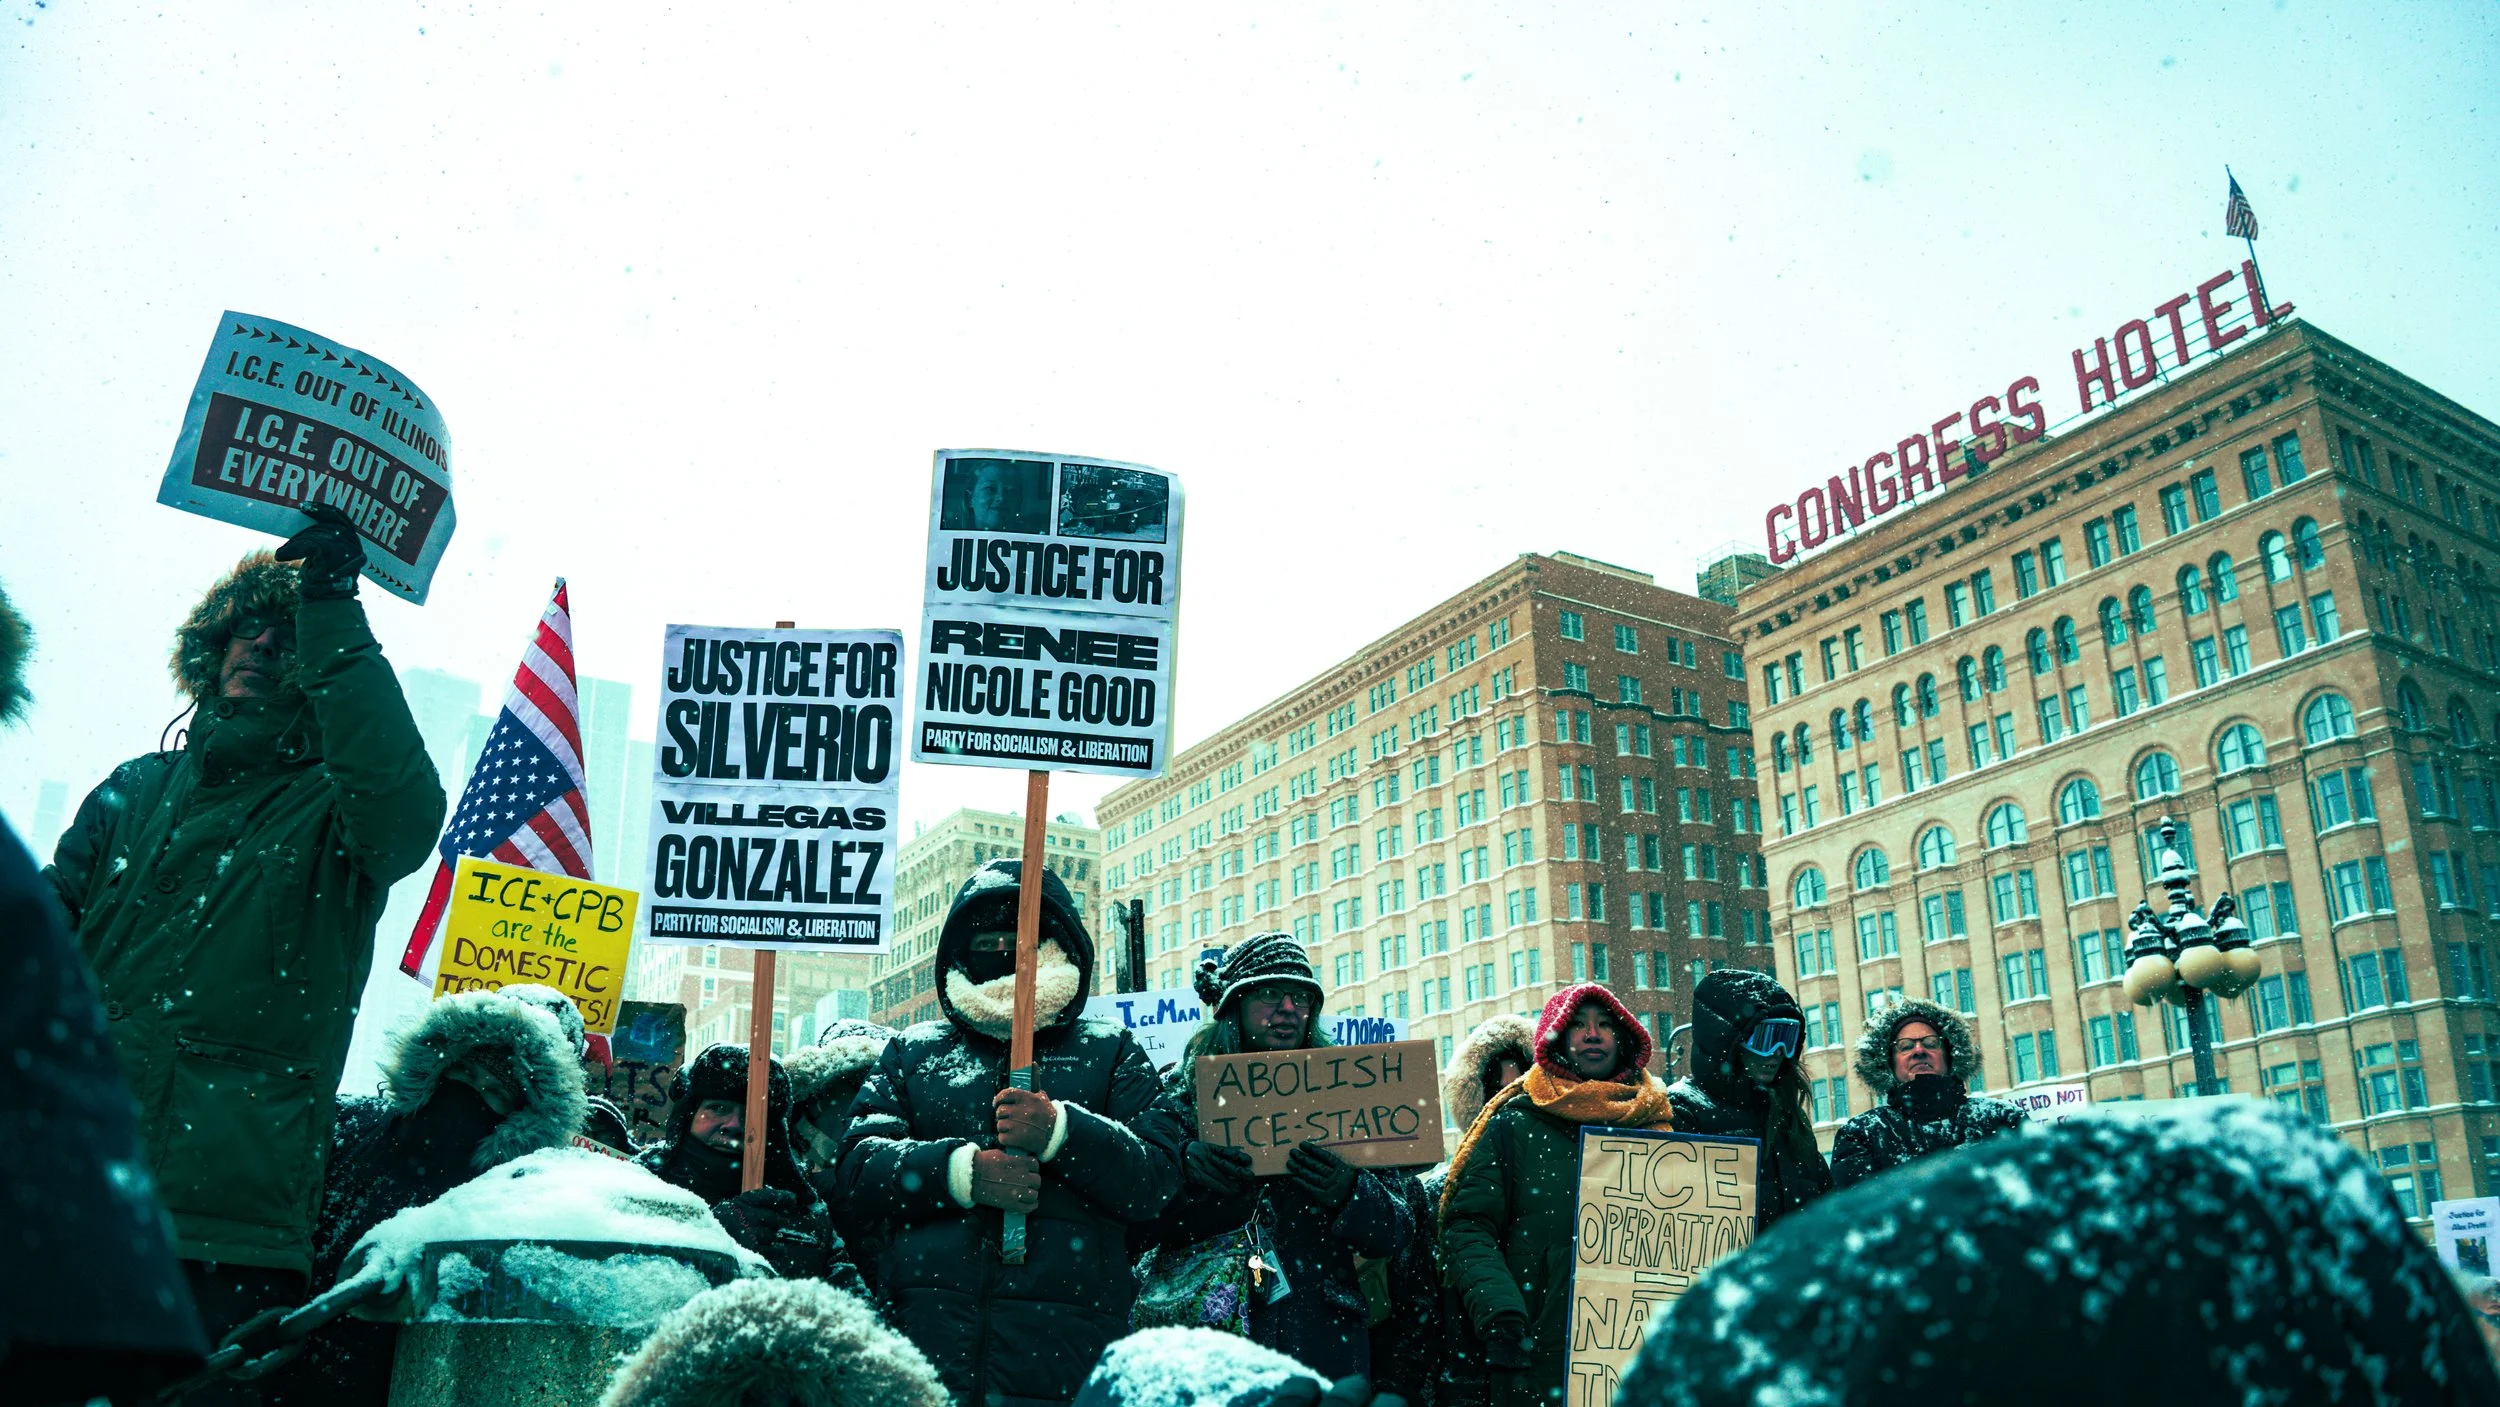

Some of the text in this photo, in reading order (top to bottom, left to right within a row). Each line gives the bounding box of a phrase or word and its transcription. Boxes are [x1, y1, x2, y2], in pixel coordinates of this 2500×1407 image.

[225, 351, 449, 473] I.C.E. OUT OF ILLINOIS
[1766, 259, 2296, 564] CONGRESS HOTEL
[233, 406, 426, 512] I.C.E. OUT OF
[219, 446, 410, 551] EVERYWHERE
[936, 538, 1164, 605] JUSTICE FOR
[667, 638, 898, 699] JUSTICE FOR
[930, 620, 1159, 671] RENEE
[925, 662, 1156, 727] NICOLE GOOD
[661, 699, 893, 784] SILVERIO
[926, 728, 1148, 763] PARTY FOR SOCIALISM & LIBERATION
[660, 800, 887, 831] VILLEGAS
[654, 833, 885, 906] GONZALEZ
[491, 918, 579, 953] are the
[654, 913, 876, 939] PARTY FOR SOCIALISM & LIBERATION
[453, 937, 610, 993] DOMESTIC
[1213, 1053, 1402, 1099] ABOLISH
[2029, 1095, 2051, 1111] DID
[2057, 1089, 2084, 1105] NOT
[1213, 1104, 1420, 1150] ICE-STAPO
[1600, 1141, 1742, 1211] ICE
[1578, 1202, 1754, 1274] OPERATION
